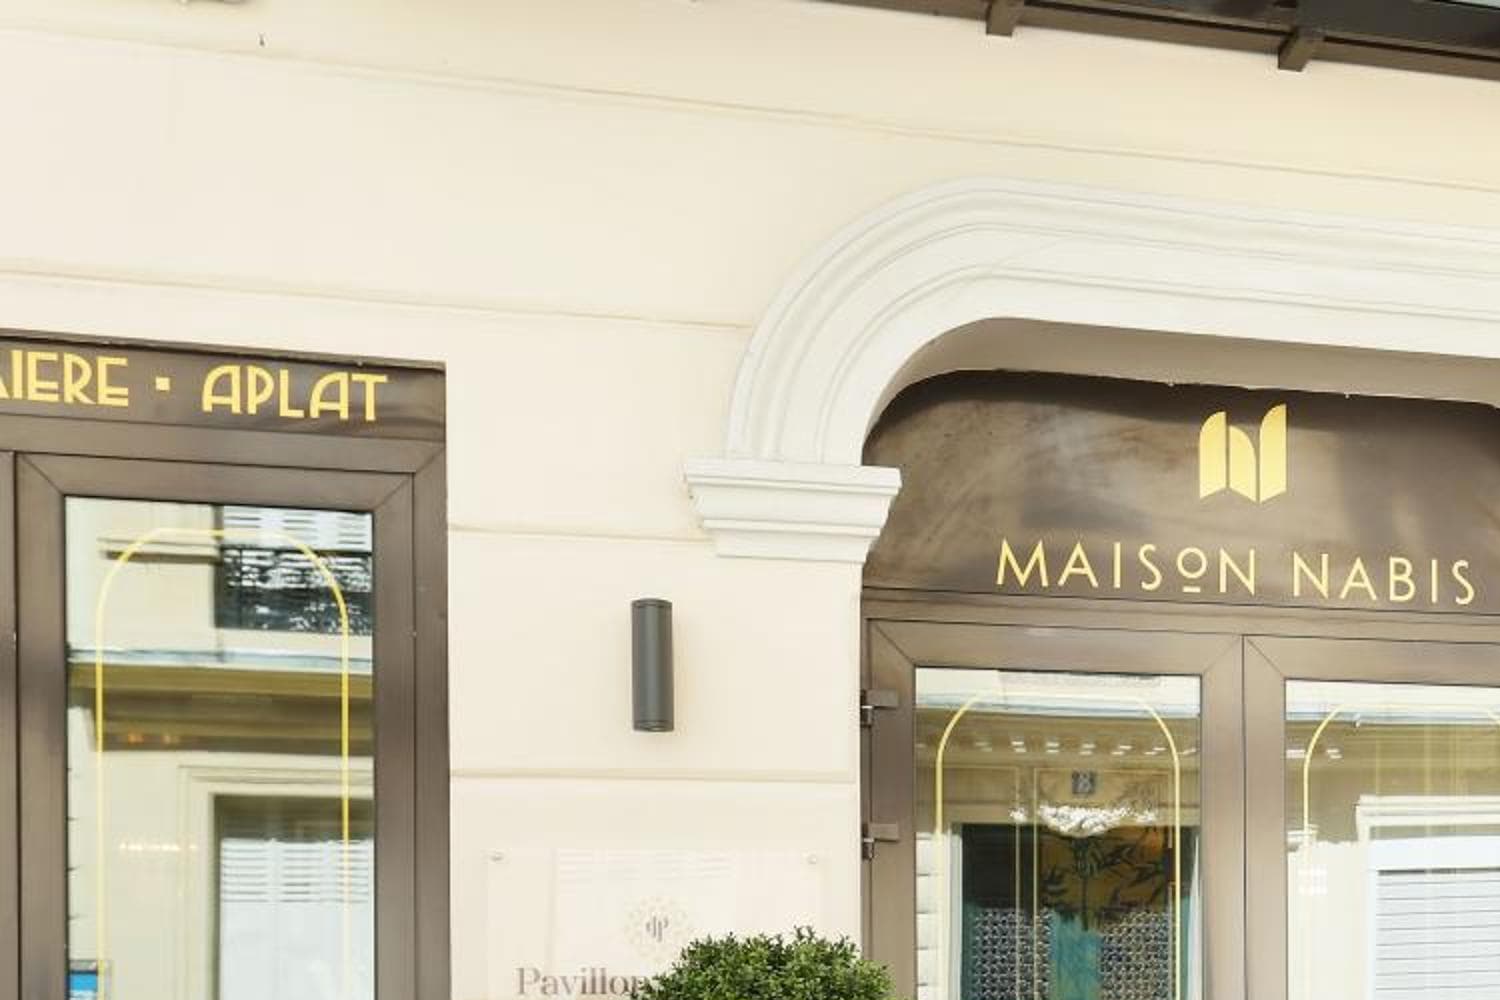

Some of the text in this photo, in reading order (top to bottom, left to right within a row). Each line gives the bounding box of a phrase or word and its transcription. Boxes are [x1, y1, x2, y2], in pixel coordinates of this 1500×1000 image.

[0, 349, 388, 422] IERE APLAT
[1292, 551, 1475, 605] NABIS
